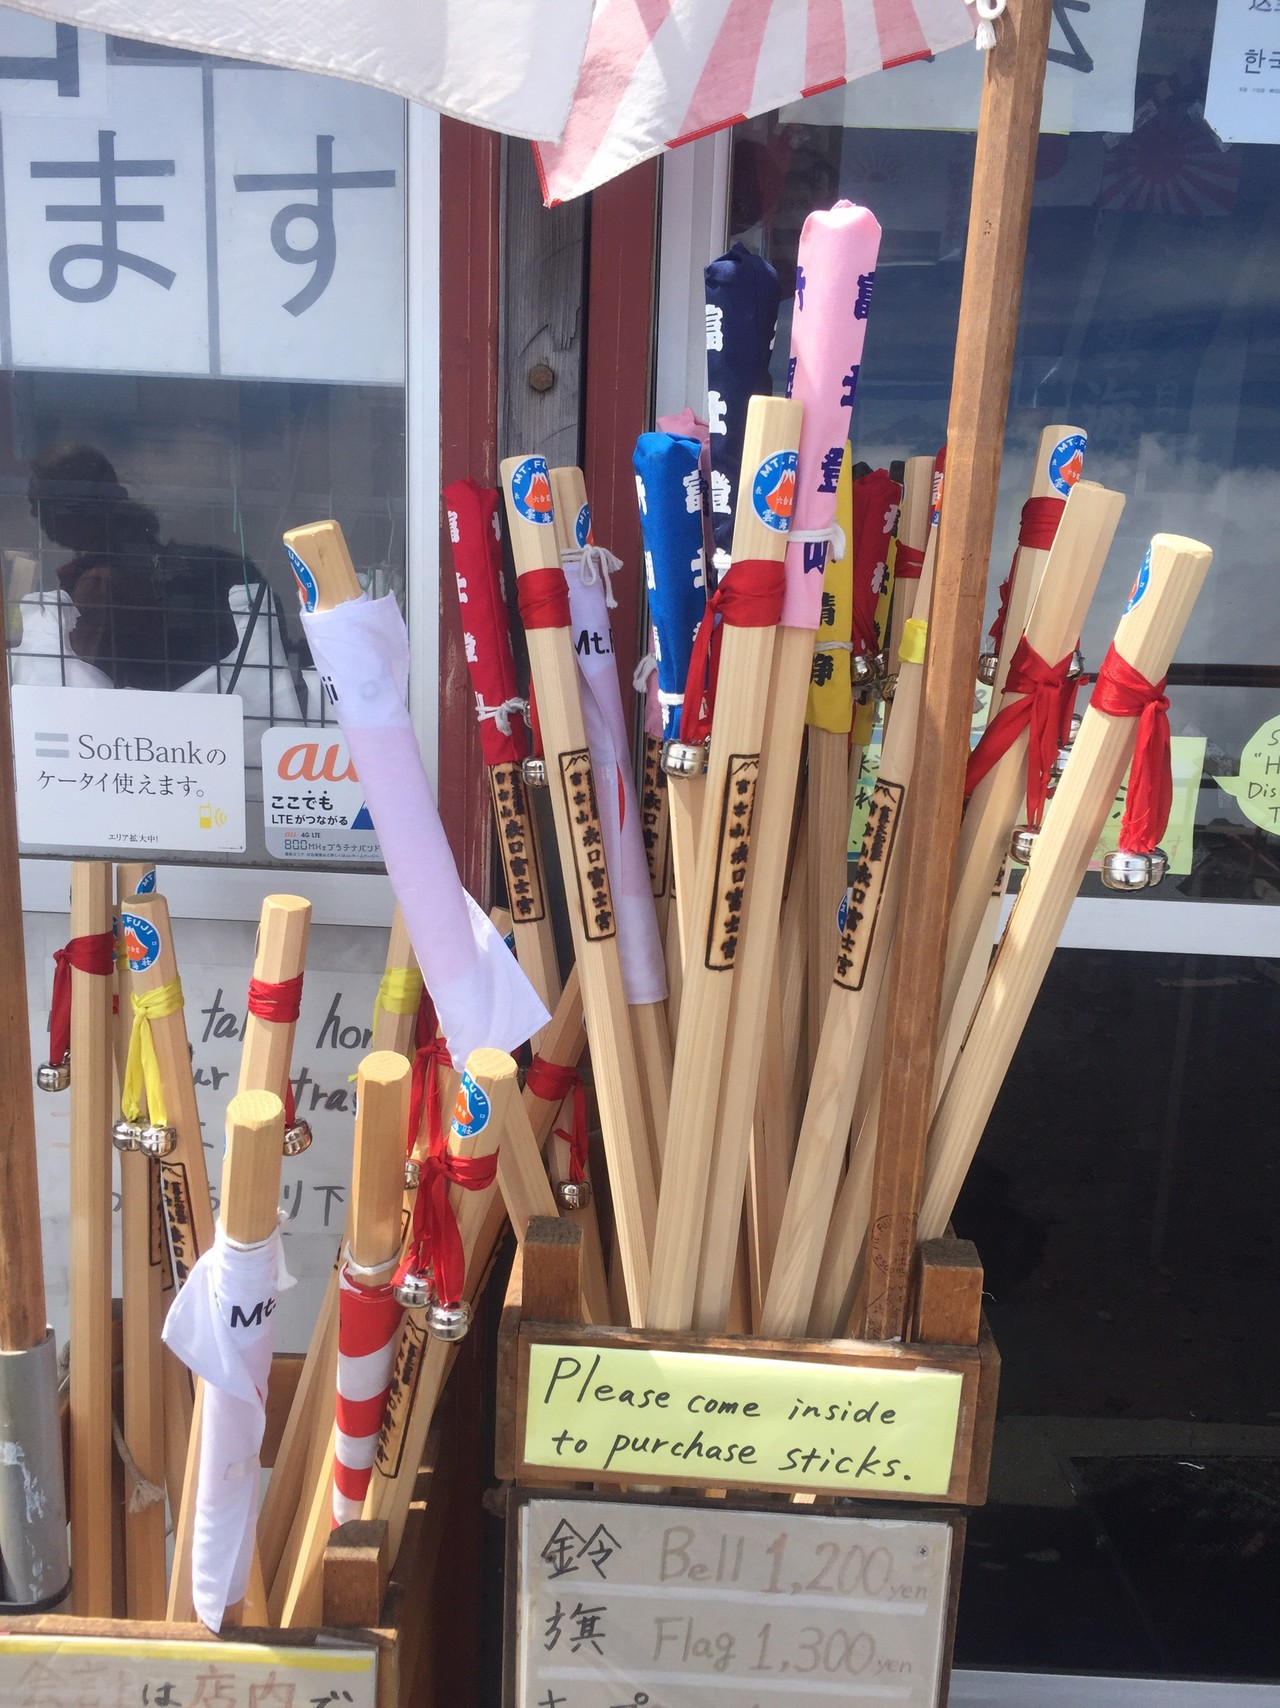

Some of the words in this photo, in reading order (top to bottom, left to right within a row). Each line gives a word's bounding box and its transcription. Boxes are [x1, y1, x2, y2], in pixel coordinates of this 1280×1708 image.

[77, 733, 227, 767] SoftBankの
[277, 743, 360, 783] au
[36, 769, 206, 799] ケータイ使えます。
[271, 795, 334, 812] ここでも
[271, 813, 349, 826] LTEがつながる
[201, 988, 246, 1042] ta
[543, 1354, 670, 1409] Please
[687, 1393, 762, 1418] come
[788, 1398, 897, 1426] inside
[551, 1429, 588, 1456] to
[602, 1430, 759, 1470] purchase
[541, 1517, 623, 1580] 鈴
[659, 1525, 745, 1582] Bell
[543, 1600, 608, 1656] 旗
[652, 1615, 736, 1673] Flag
